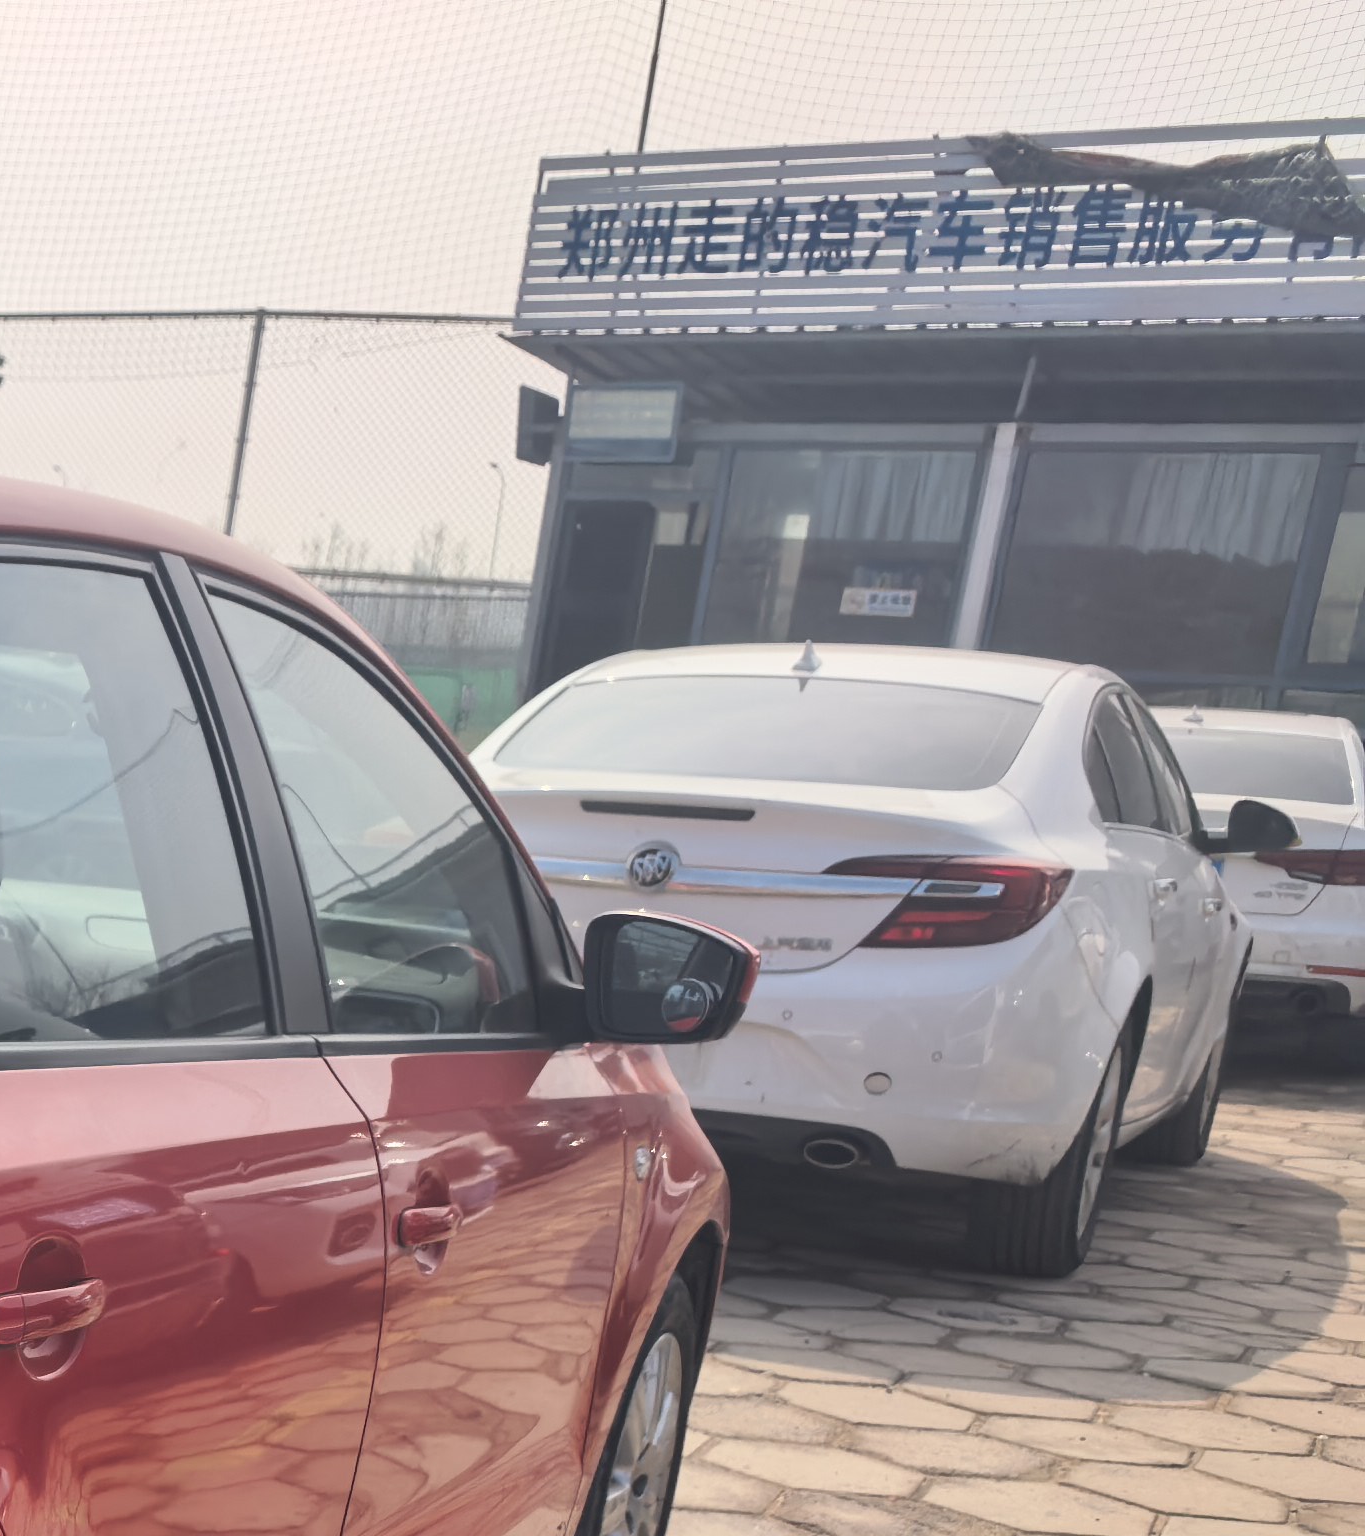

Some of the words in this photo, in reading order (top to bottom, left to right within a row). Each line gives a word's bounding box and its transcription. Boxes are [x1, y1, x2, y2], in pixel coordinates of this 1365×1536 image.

[557, 183, 1365, 282] 郑州走的稳汽车销售服务
